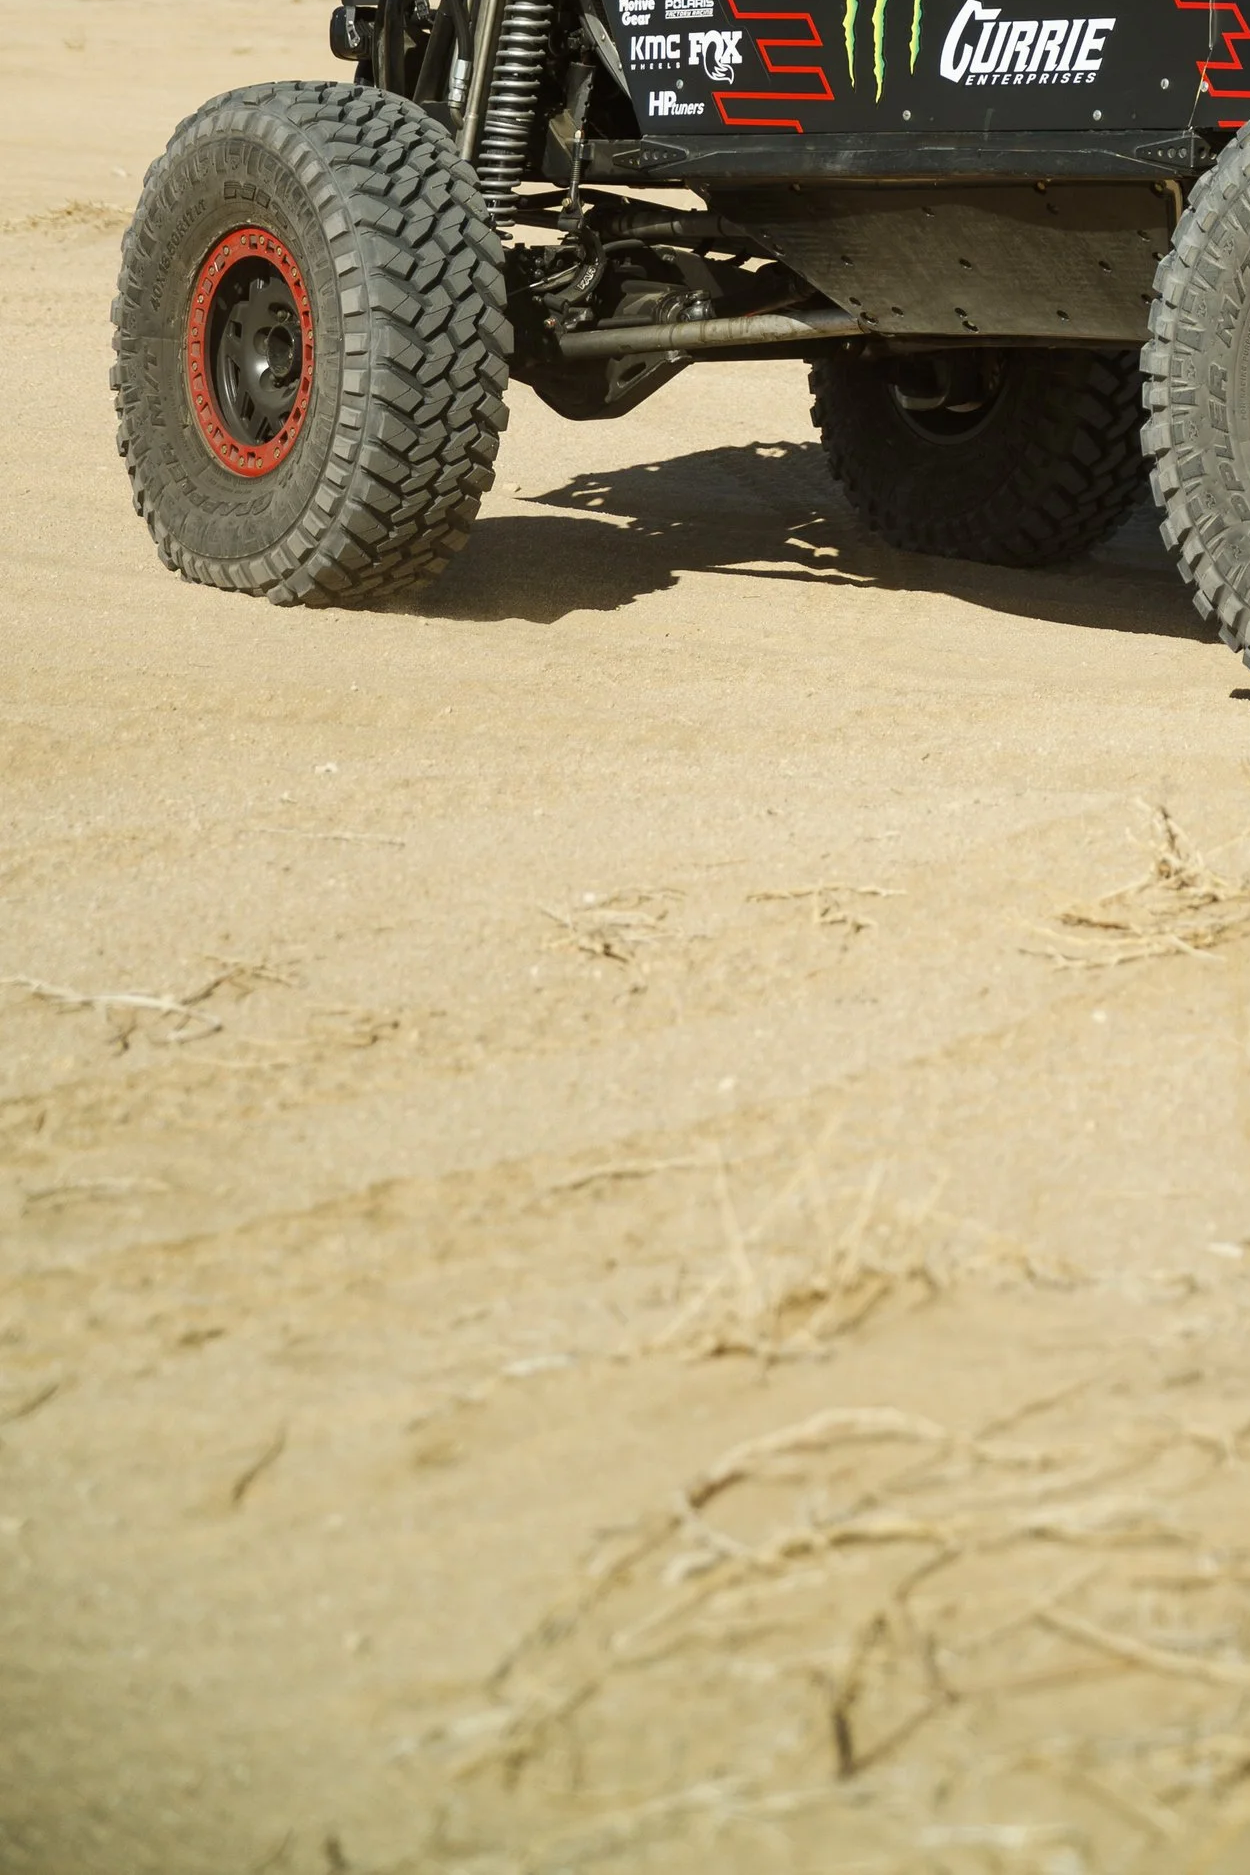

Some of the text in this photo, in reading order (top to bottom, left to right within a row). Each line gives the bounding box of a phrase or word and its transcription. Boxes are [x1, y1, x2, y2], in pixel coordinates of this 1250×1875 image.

[622, 13, 650, 25] Gear
[631, 34, 680, 61] KMC
[689, 30, 742, 72] FOX
[965, 72, 1097, 86] ENTERPRISES
